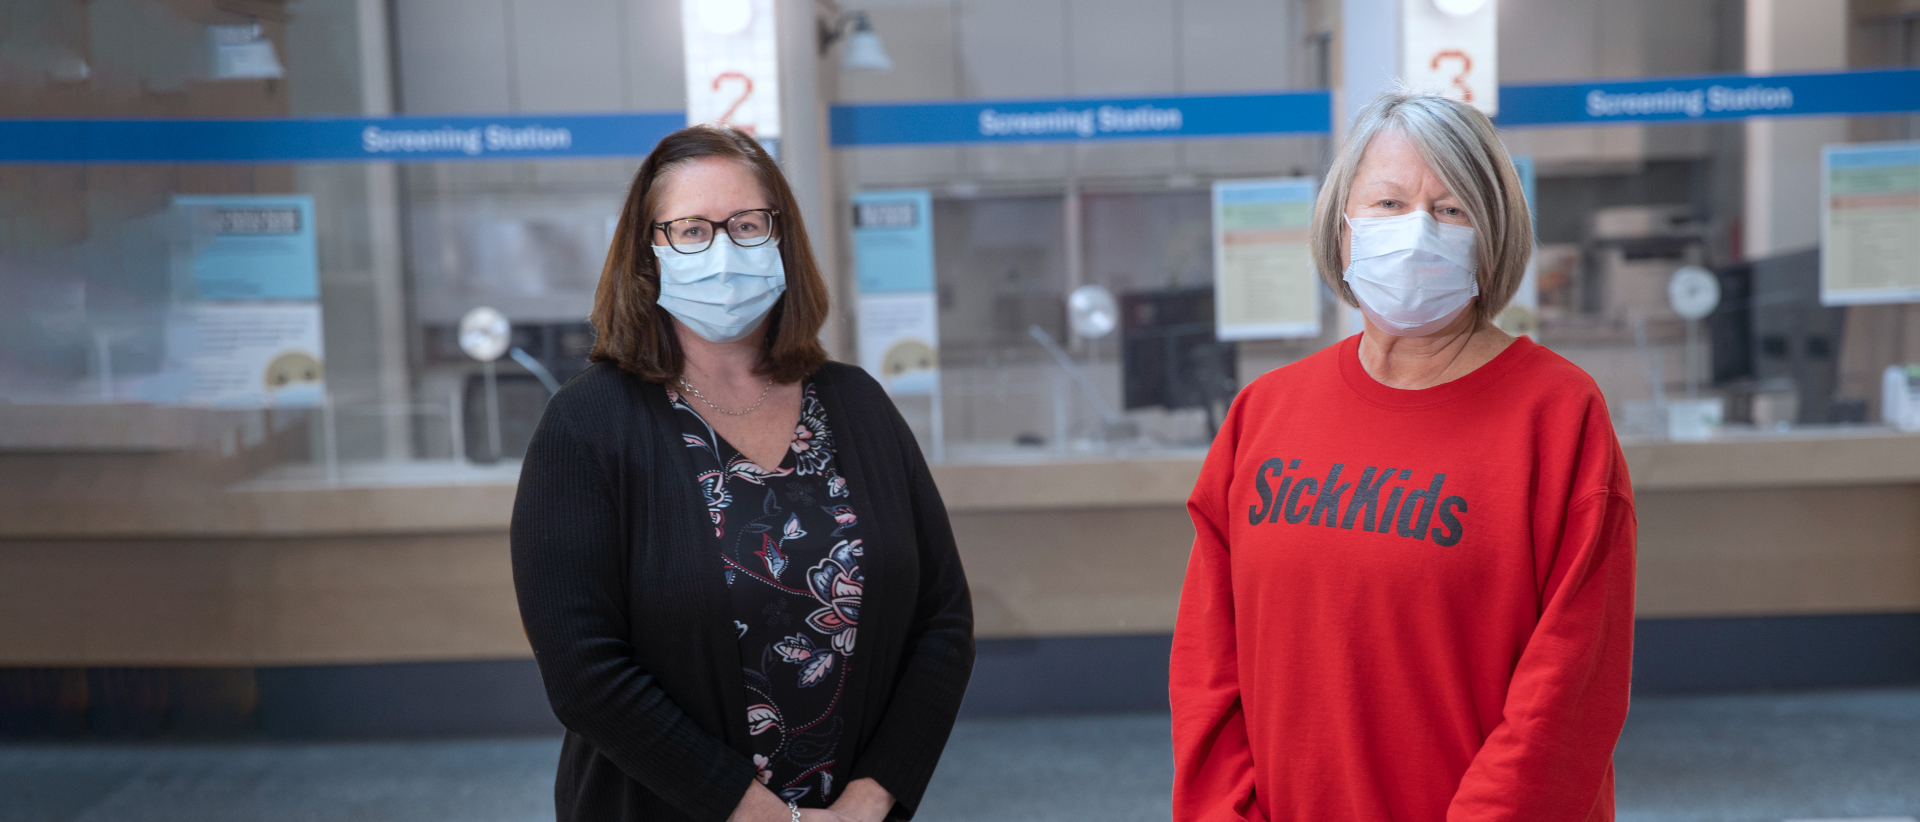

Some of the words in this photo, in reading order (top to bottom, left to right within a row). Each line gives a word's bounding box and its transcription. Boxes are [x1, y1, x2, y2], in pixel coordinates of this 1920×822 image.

[711, 72, 756, 135] 2
[1588, 89, 1704, 117] Screening
[1708, 84, 1793, 111] Station
[980, 108, 1095, 136] Screening
[1099, 105, 1182, 132] Station
[363, 125, 481, 155] Screening
[487, 124, 571, 151] Station
[1248, 457, 1468, 547] SickKids
